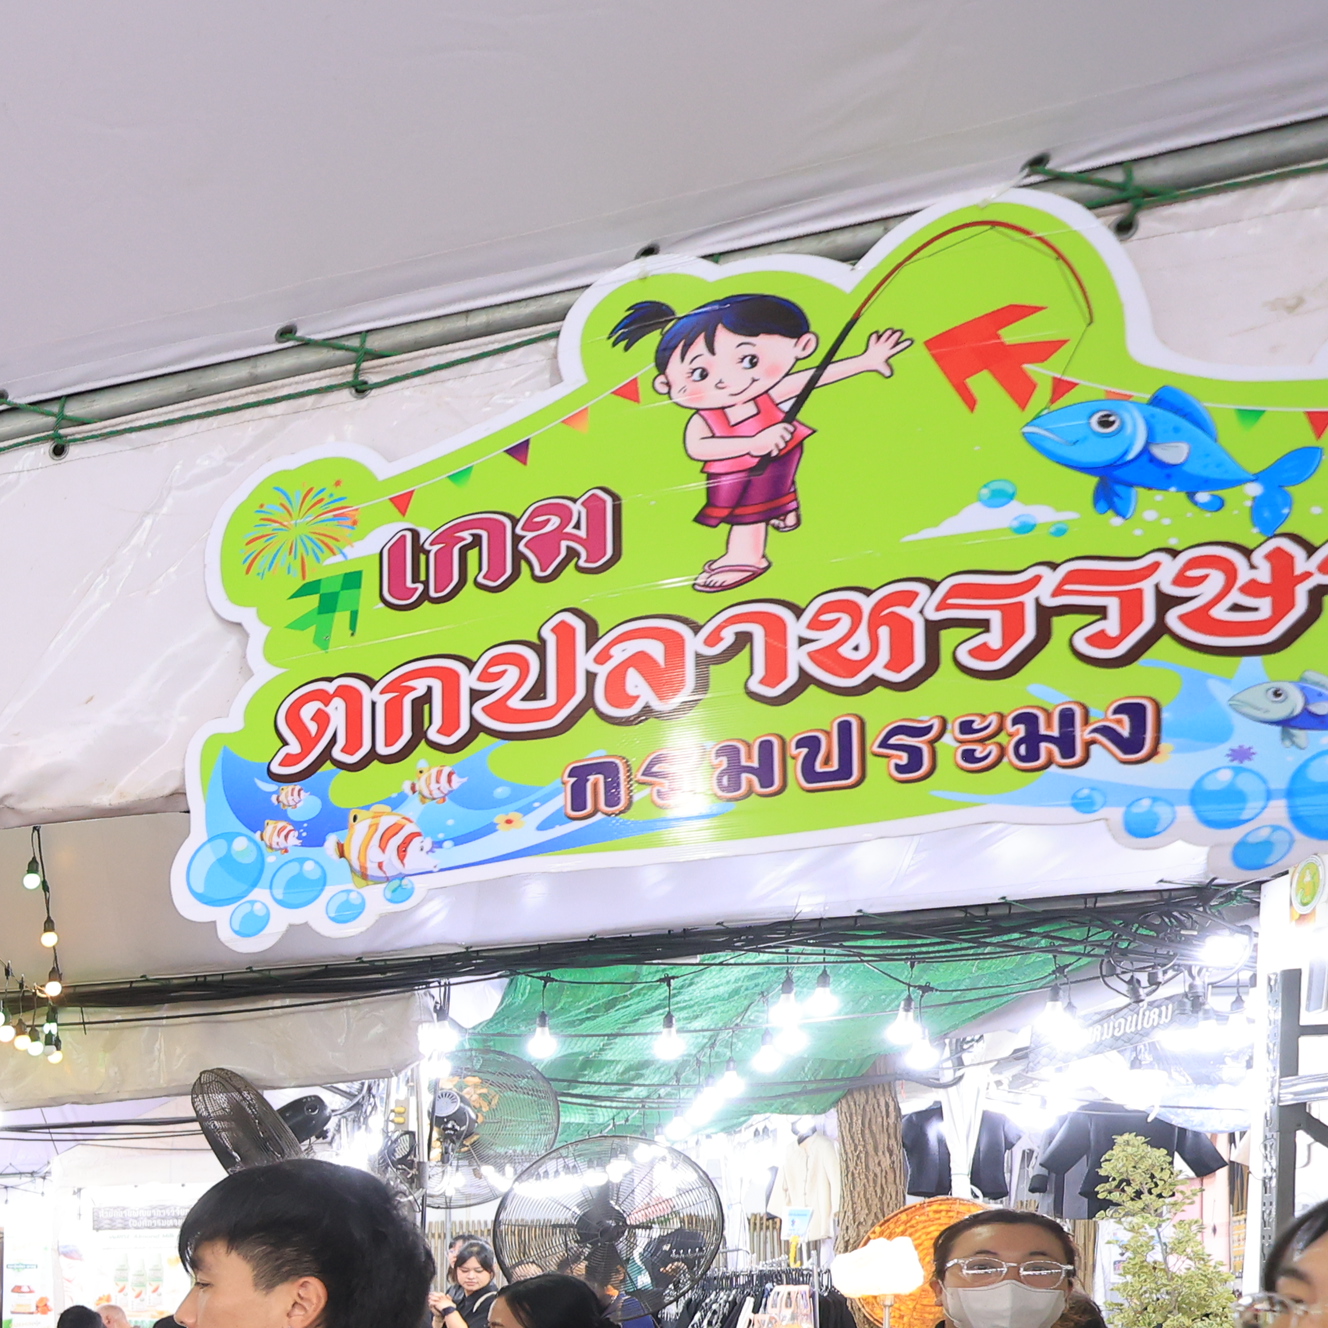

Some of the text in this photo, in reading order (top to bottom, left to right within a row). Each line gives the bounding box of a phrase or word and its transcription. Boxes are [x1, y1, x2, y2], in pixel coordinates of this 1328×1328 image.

[379, 487, 622, 610] เกม
[564, 694, 1161, 823] กรมประมง
